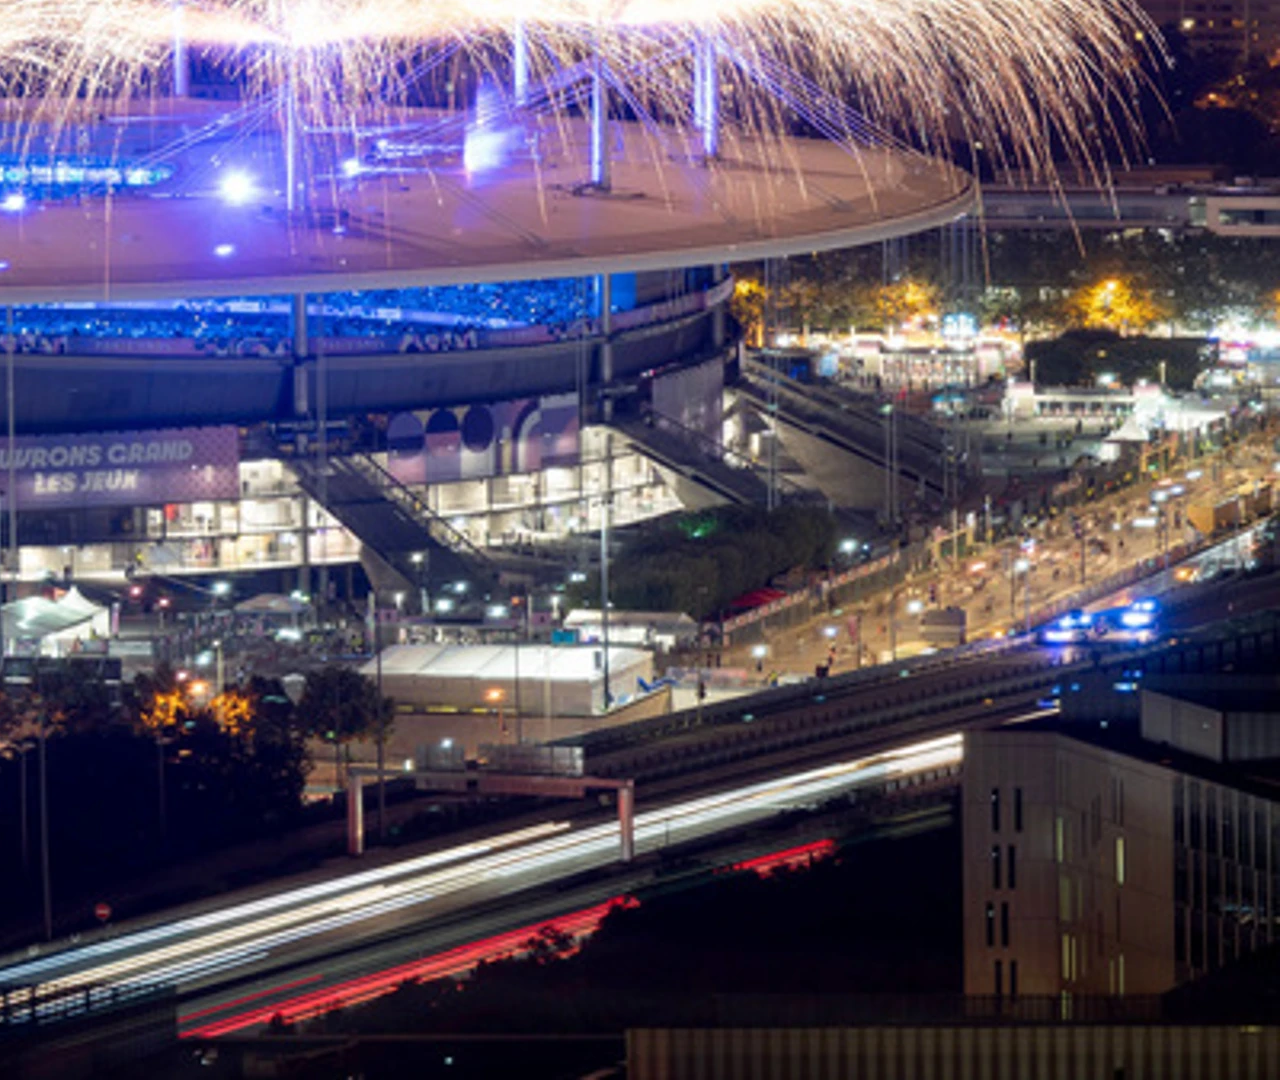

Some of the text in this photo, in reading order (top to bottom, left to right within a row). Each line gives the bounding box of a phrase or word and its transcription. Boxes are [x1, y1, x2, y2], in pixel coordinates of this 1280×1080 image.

[108, 440, 194, 464] GRAND
[34, 469, 140, 494] LES JEUX
